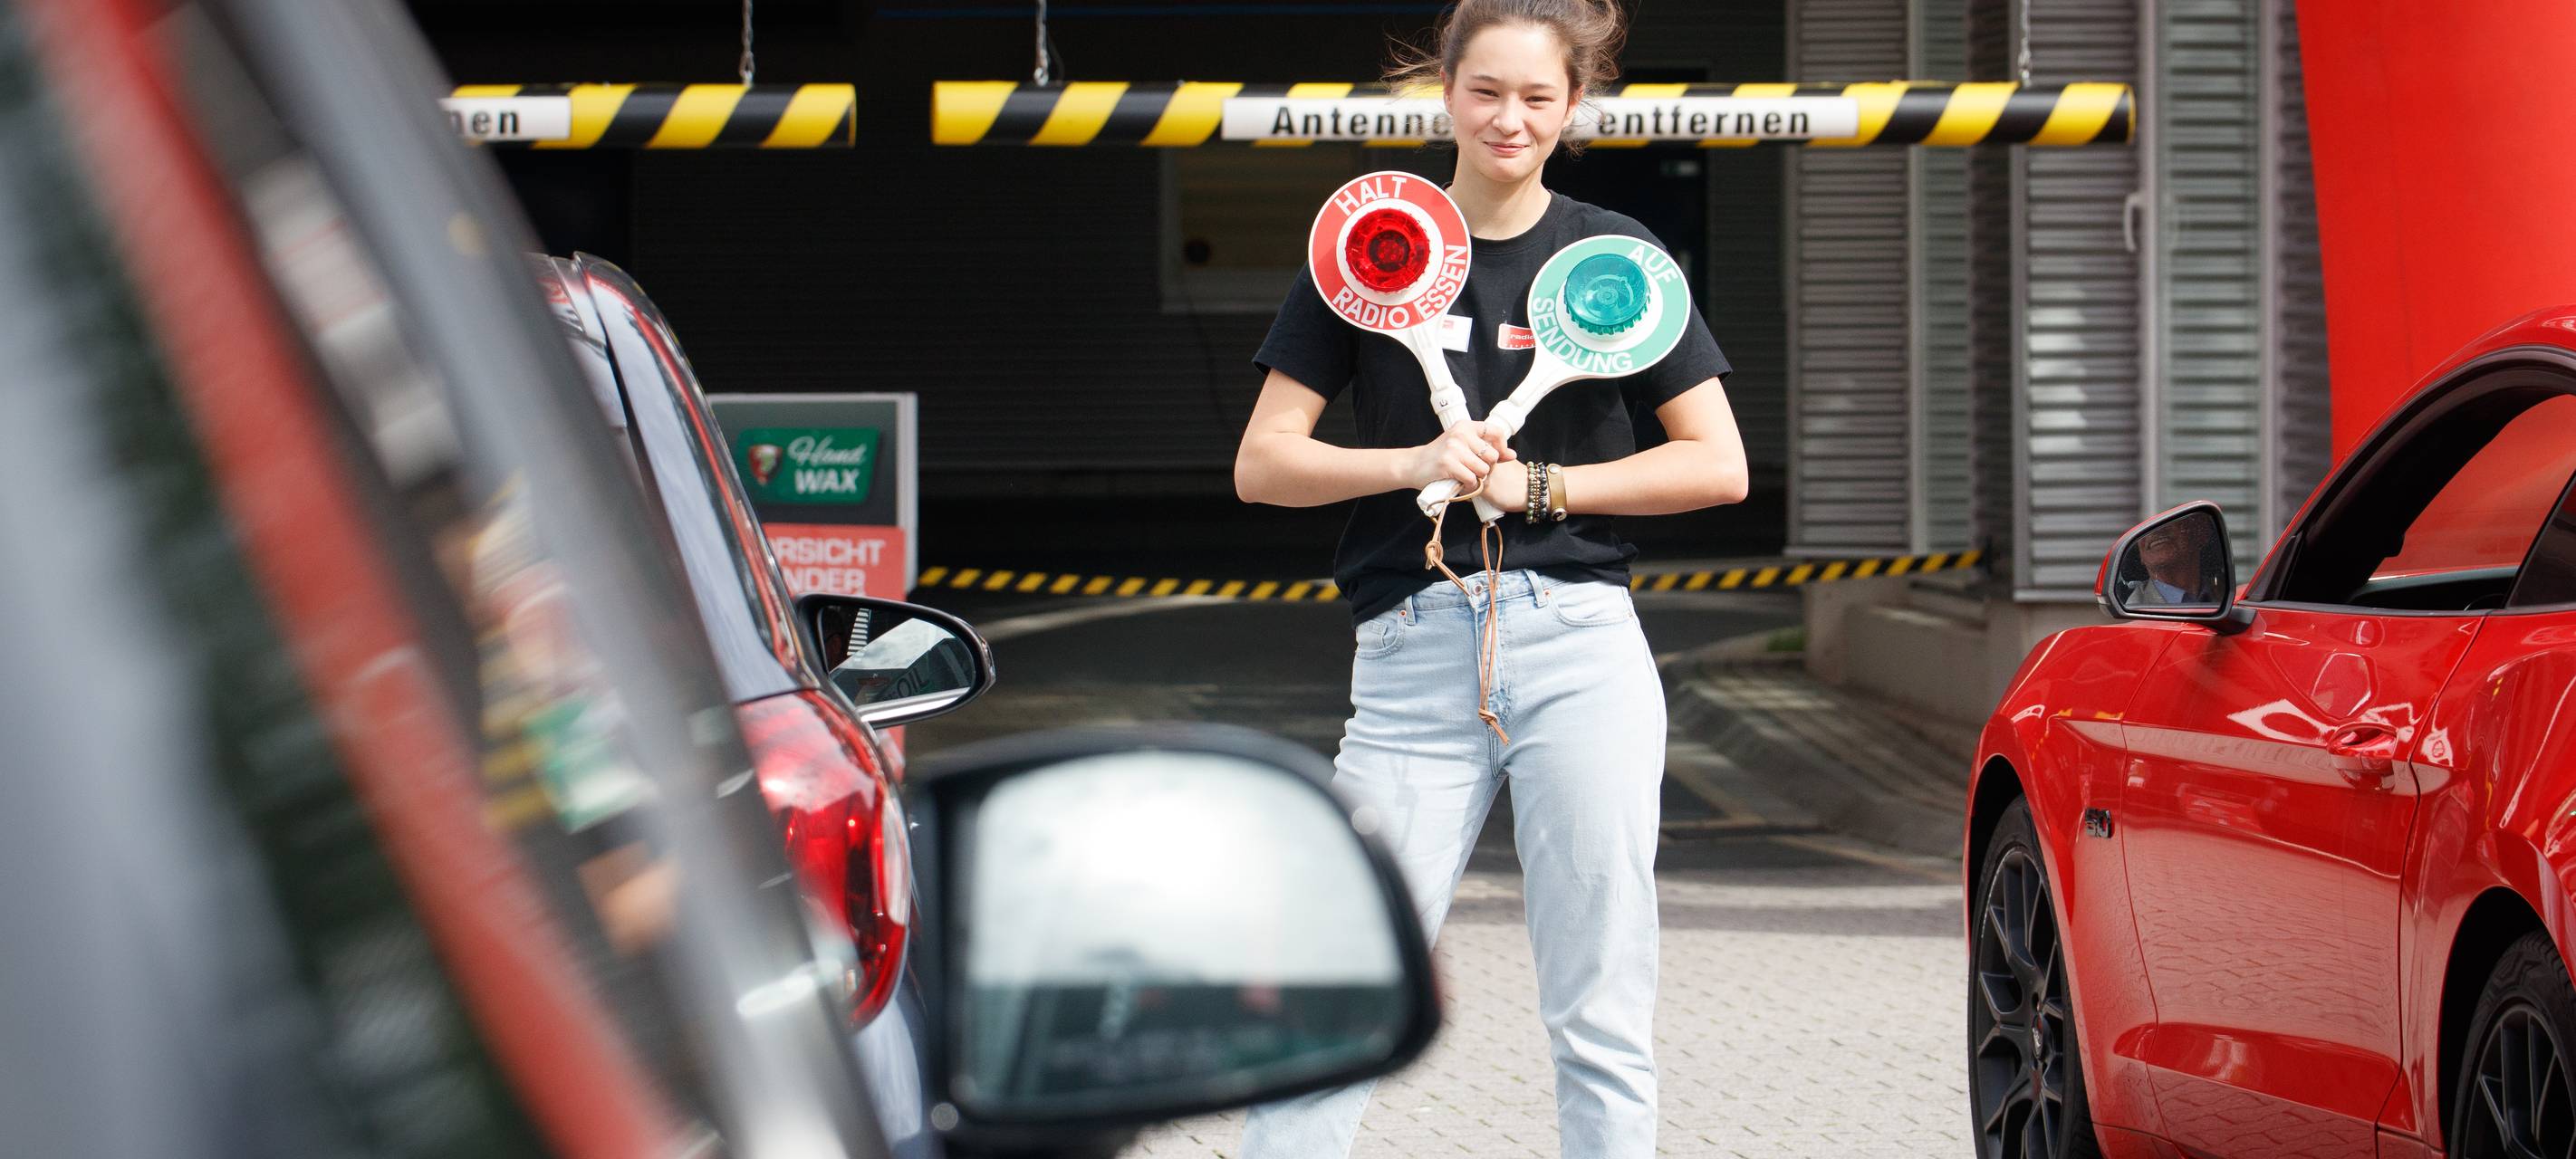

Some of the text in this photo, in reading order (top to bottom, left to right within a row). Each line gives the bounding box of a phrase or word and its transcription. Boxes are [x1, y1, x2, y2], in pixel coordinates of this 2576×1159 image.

[1272, 105, 1809, 135] Antenne entfernen
[1334, 176, 1408, 216] HALT
[1627, 244, 1678, 283] AUF
[1331, 244, 1467, 330] RADIO ESSEN
[1532, 296, 1634, 373] SENDUNG
[787, 435, 867, 465] Hand
[794, 468, 860, 494] WAX
[772, 536, 887, 566] RSICHT
